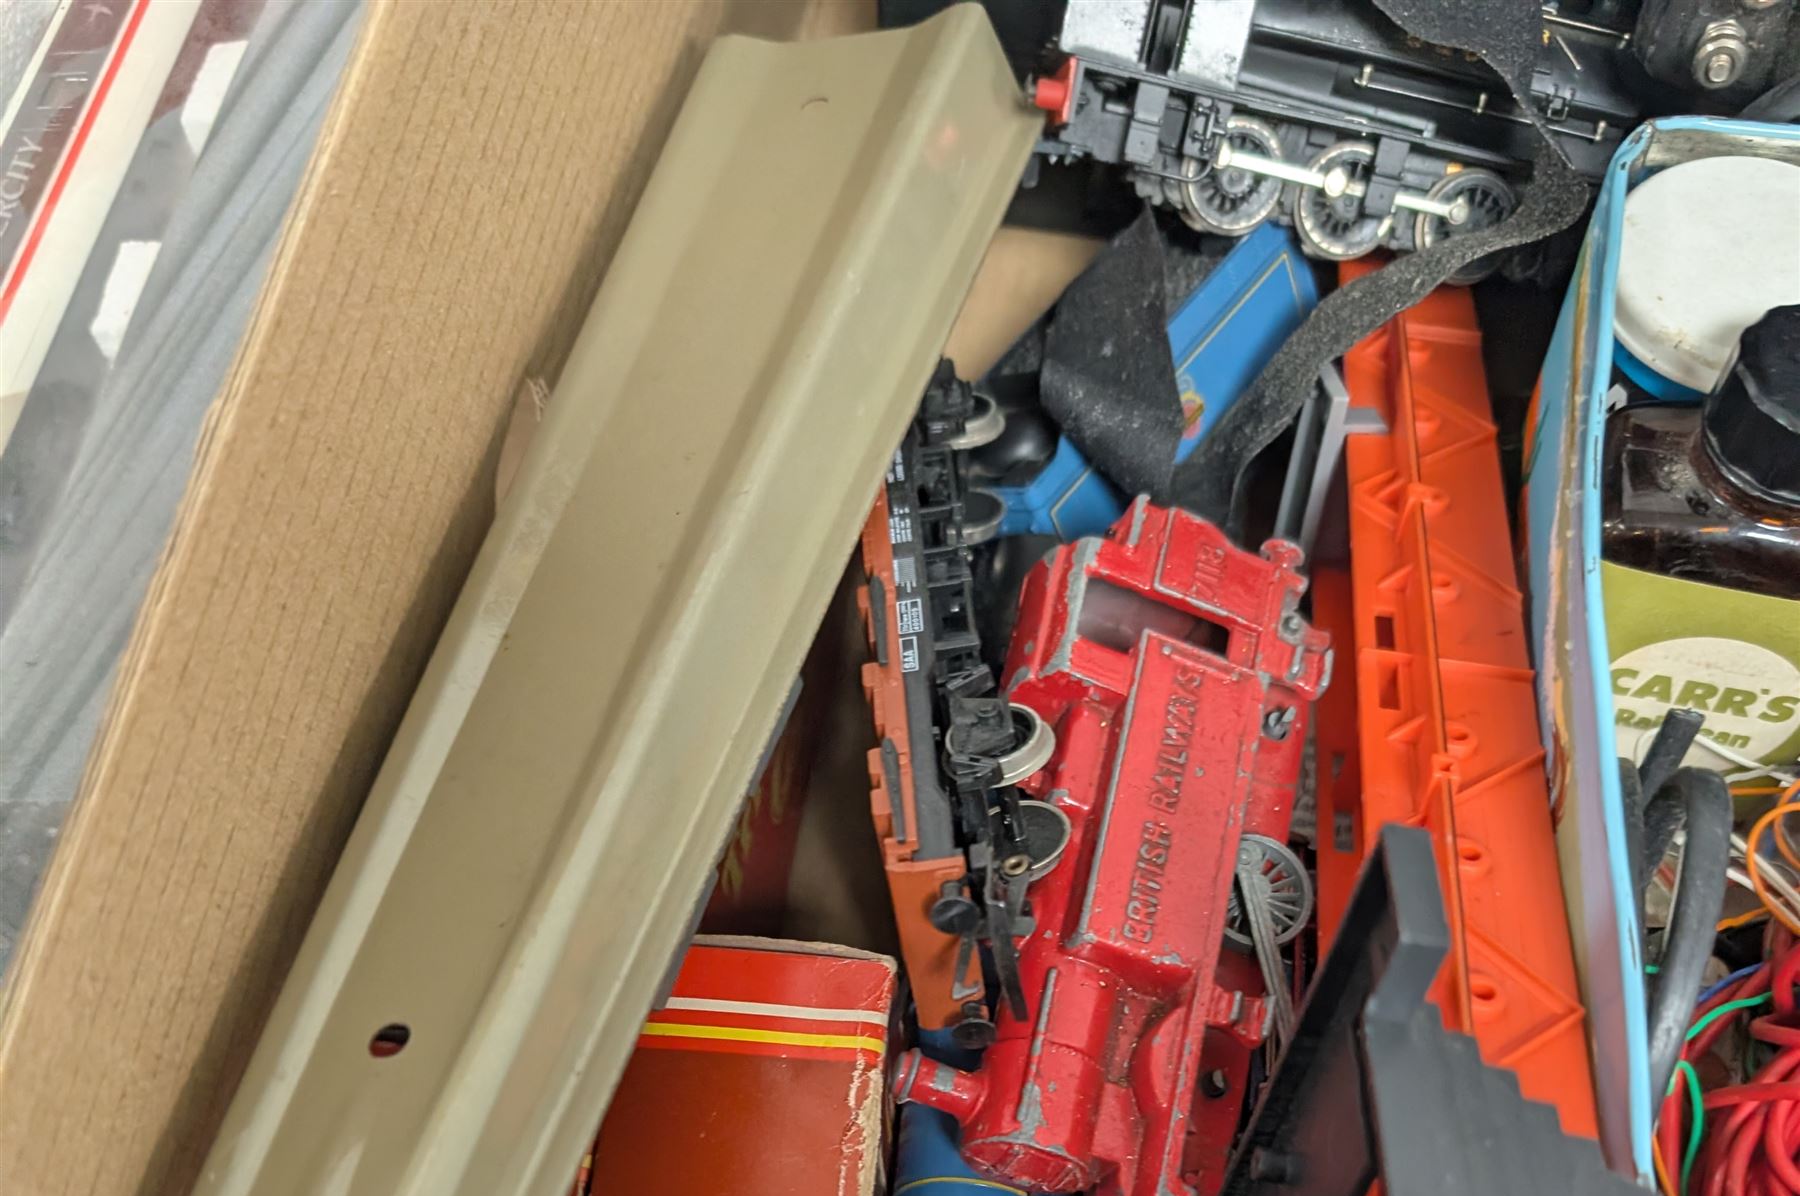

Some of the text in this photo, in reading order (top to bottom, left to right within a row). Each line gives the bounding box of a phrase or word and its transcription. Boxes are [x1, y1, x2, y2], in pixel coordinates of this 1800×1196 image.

[1610, 668, 1800, 723] CARR'S
[1122, 666, 1202, 944] BRITISH RAILWAYS
